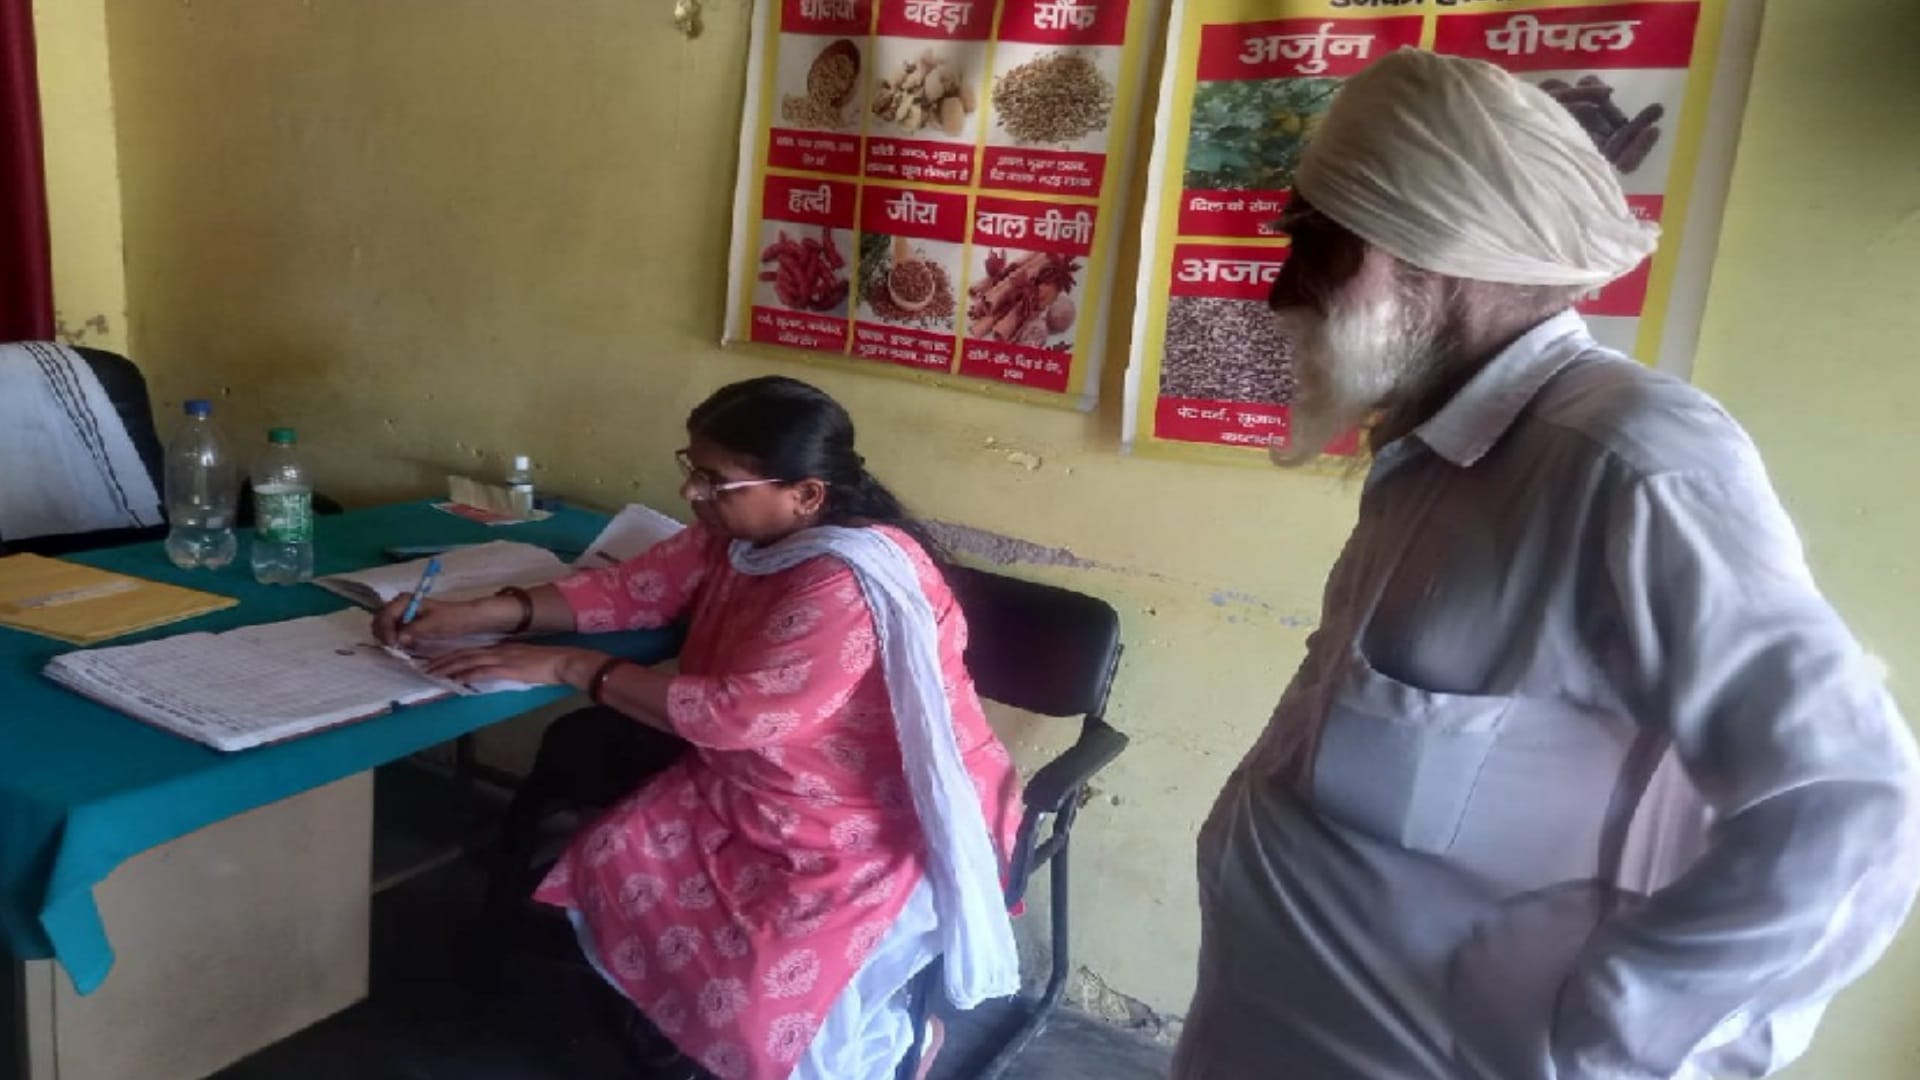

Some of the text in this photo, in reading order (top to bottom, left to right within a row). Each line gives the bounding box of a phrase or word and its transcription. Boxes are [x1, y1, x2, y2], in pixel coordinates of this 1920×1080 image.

[1239, 23, 1375, 73] अर्जुन
[1485, 15, 1642, 54] पीपल
[788, 185, 831, 214] हल्दी
[886, 192, 938, 224] जीरा
[976, 209, 1092, 244] दाल चीनी
